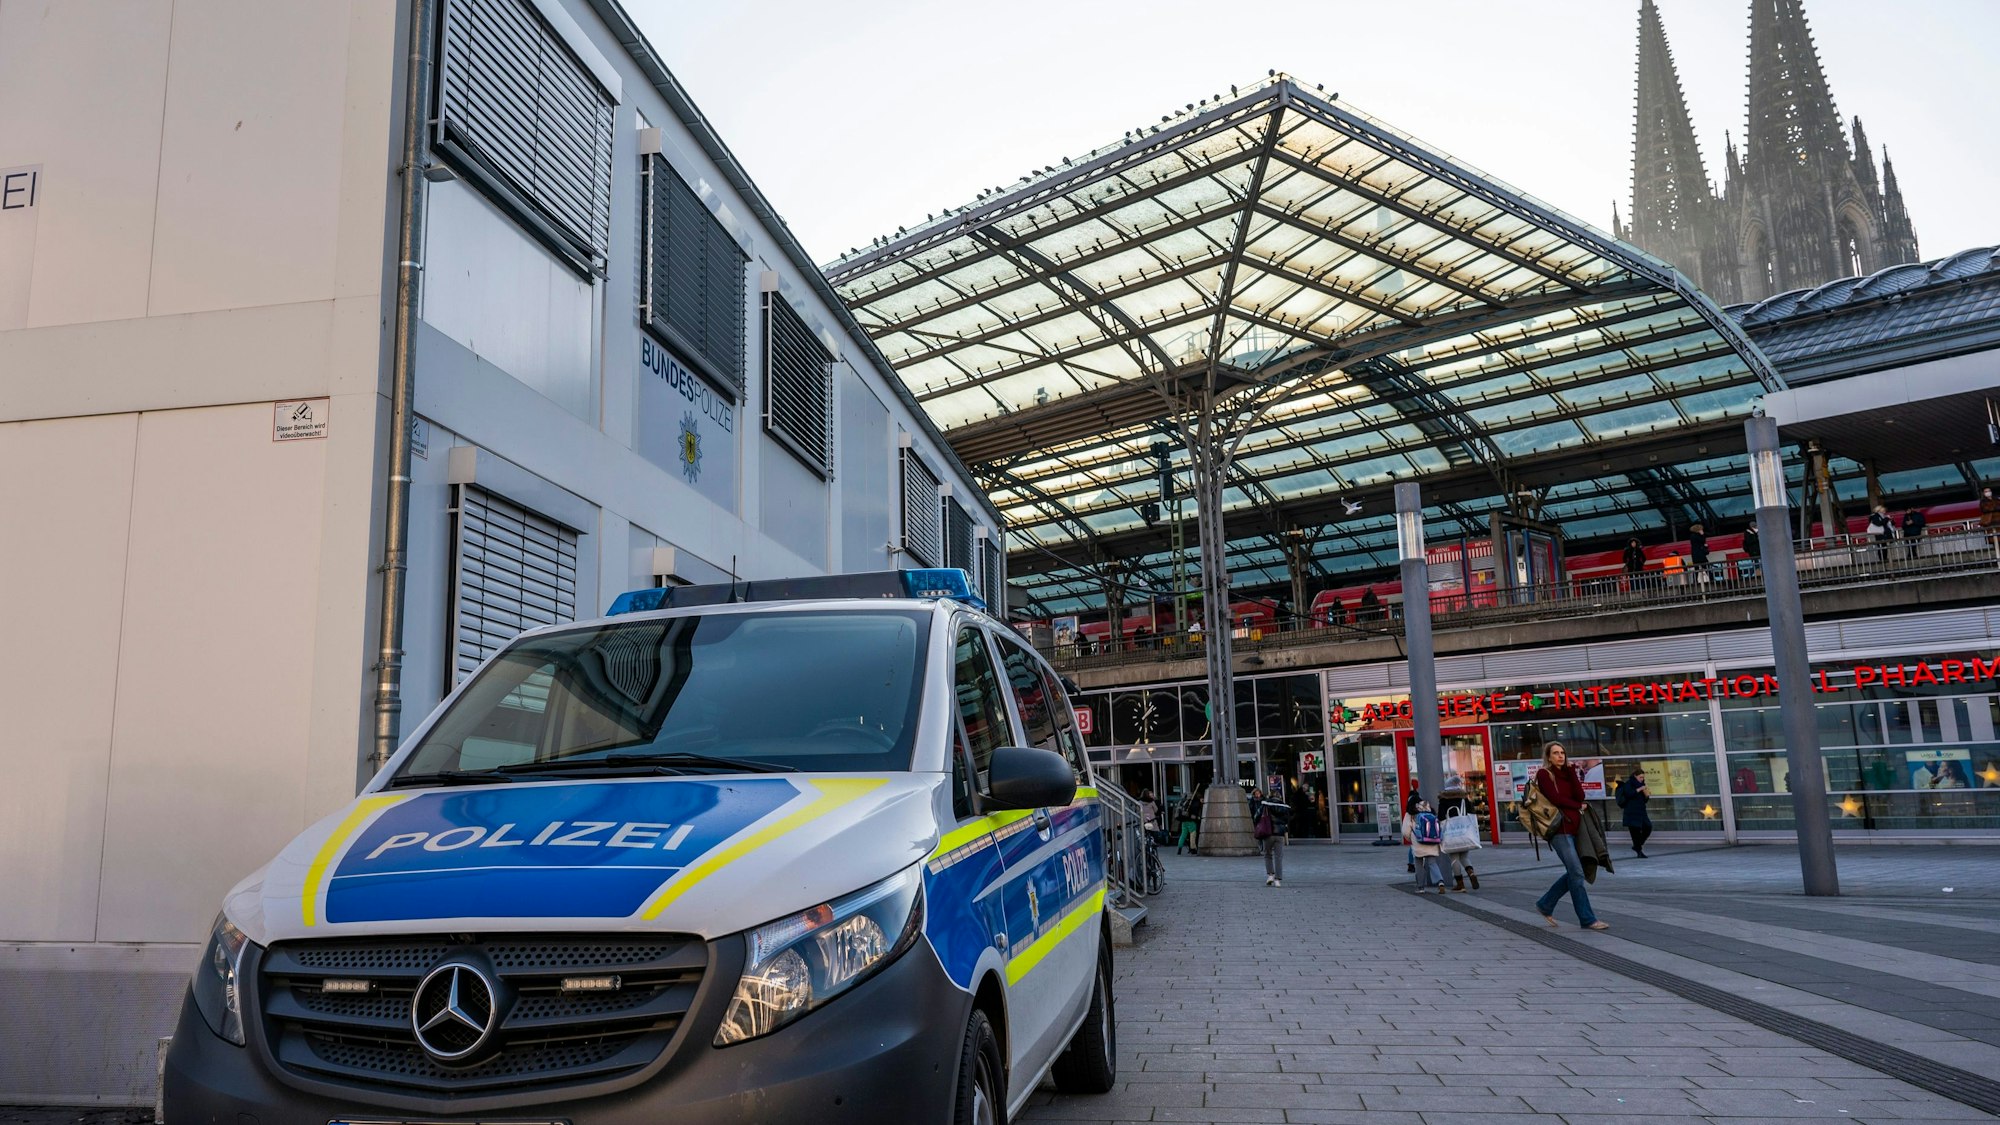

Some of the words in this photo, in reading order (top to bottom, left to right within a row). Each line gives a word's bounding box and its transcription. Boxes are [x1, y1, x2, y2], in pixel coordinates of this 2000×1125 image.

[0, 171, 37, 210] EI
[642, 336, 734, 435] BUNDESPOLIZEI
[1361, 693, 1506, 722] APOHEKE
[1554, 669, 1840, 710] INTERNATIONL
[364, 821, 695, 860] POLIZEI
[1062, 846, 1089, 899] POLIZEI
